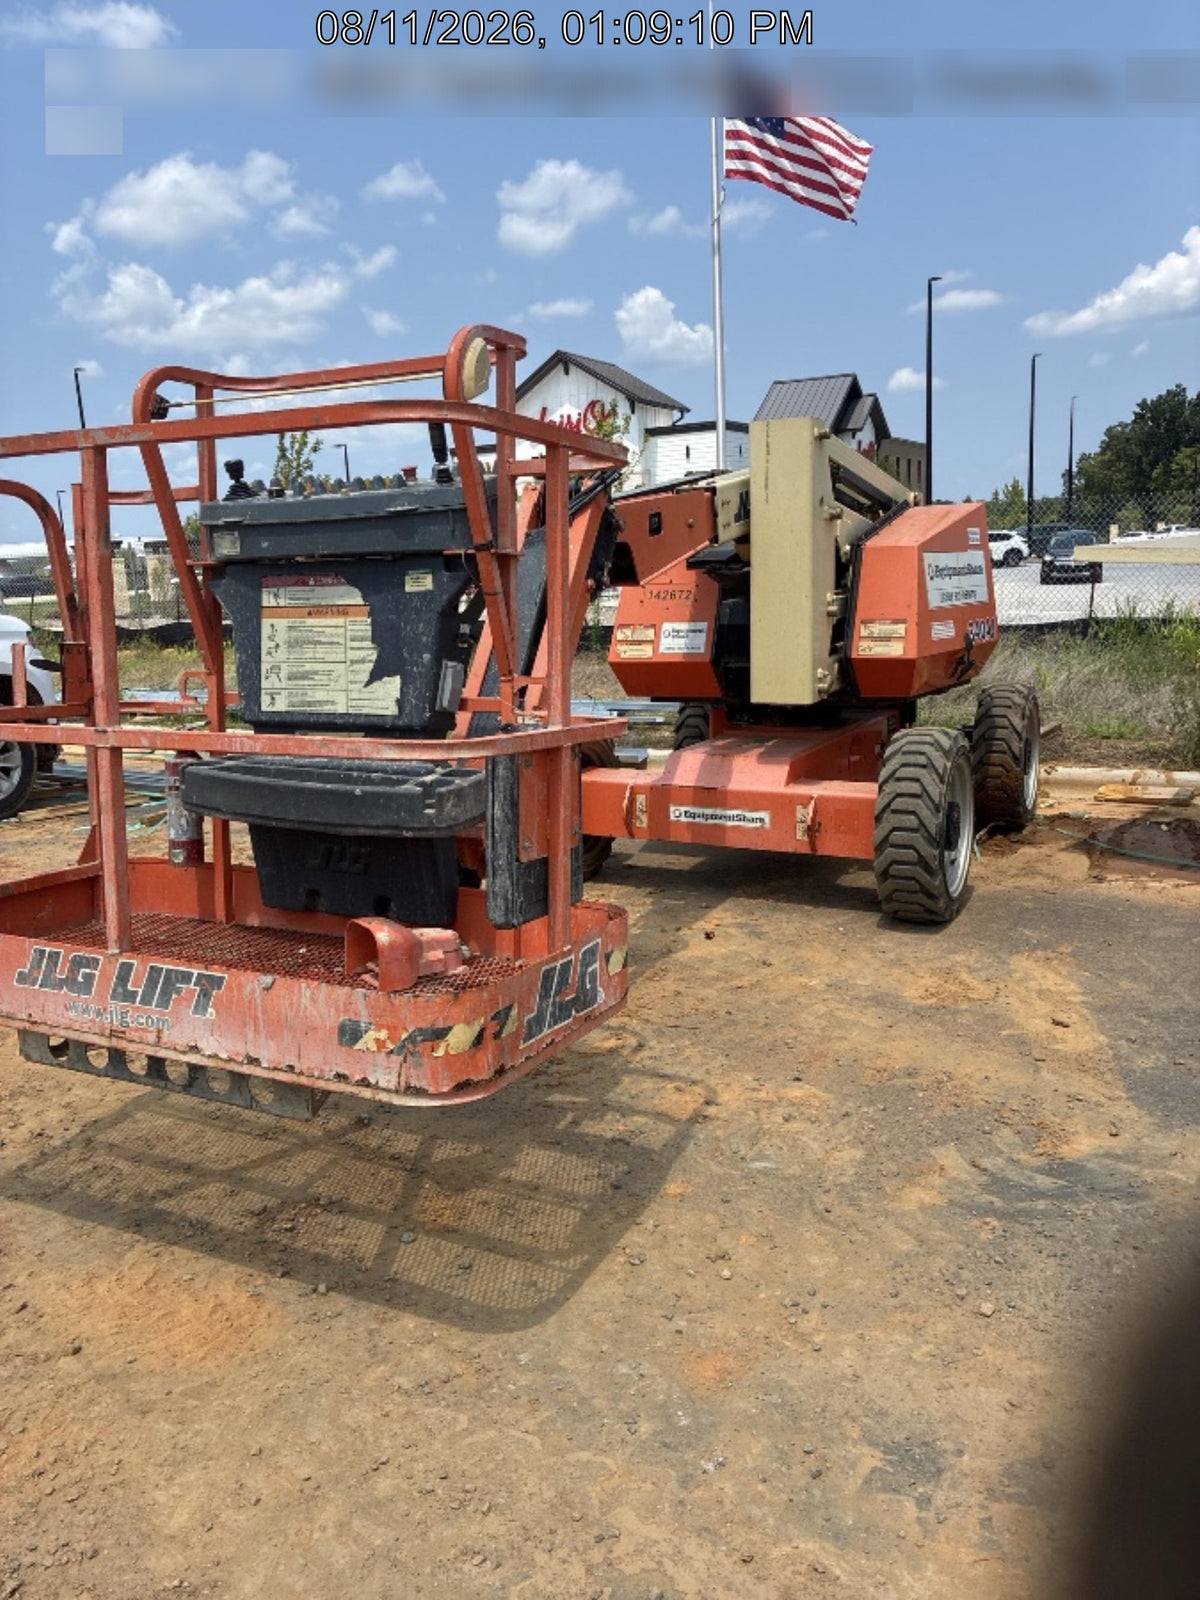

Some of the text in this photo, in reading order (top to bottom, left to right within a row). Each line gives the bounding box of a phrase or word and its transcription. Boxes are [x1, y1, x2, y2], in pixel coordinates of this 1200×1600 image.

[683, 809, 766, 825] EquipmentShare
[13, 945, 227, 1018] JLG LIFT
[518, 937, 605, 1050] JLG
[66, 1001, 171, 1032] www.jlg.com
